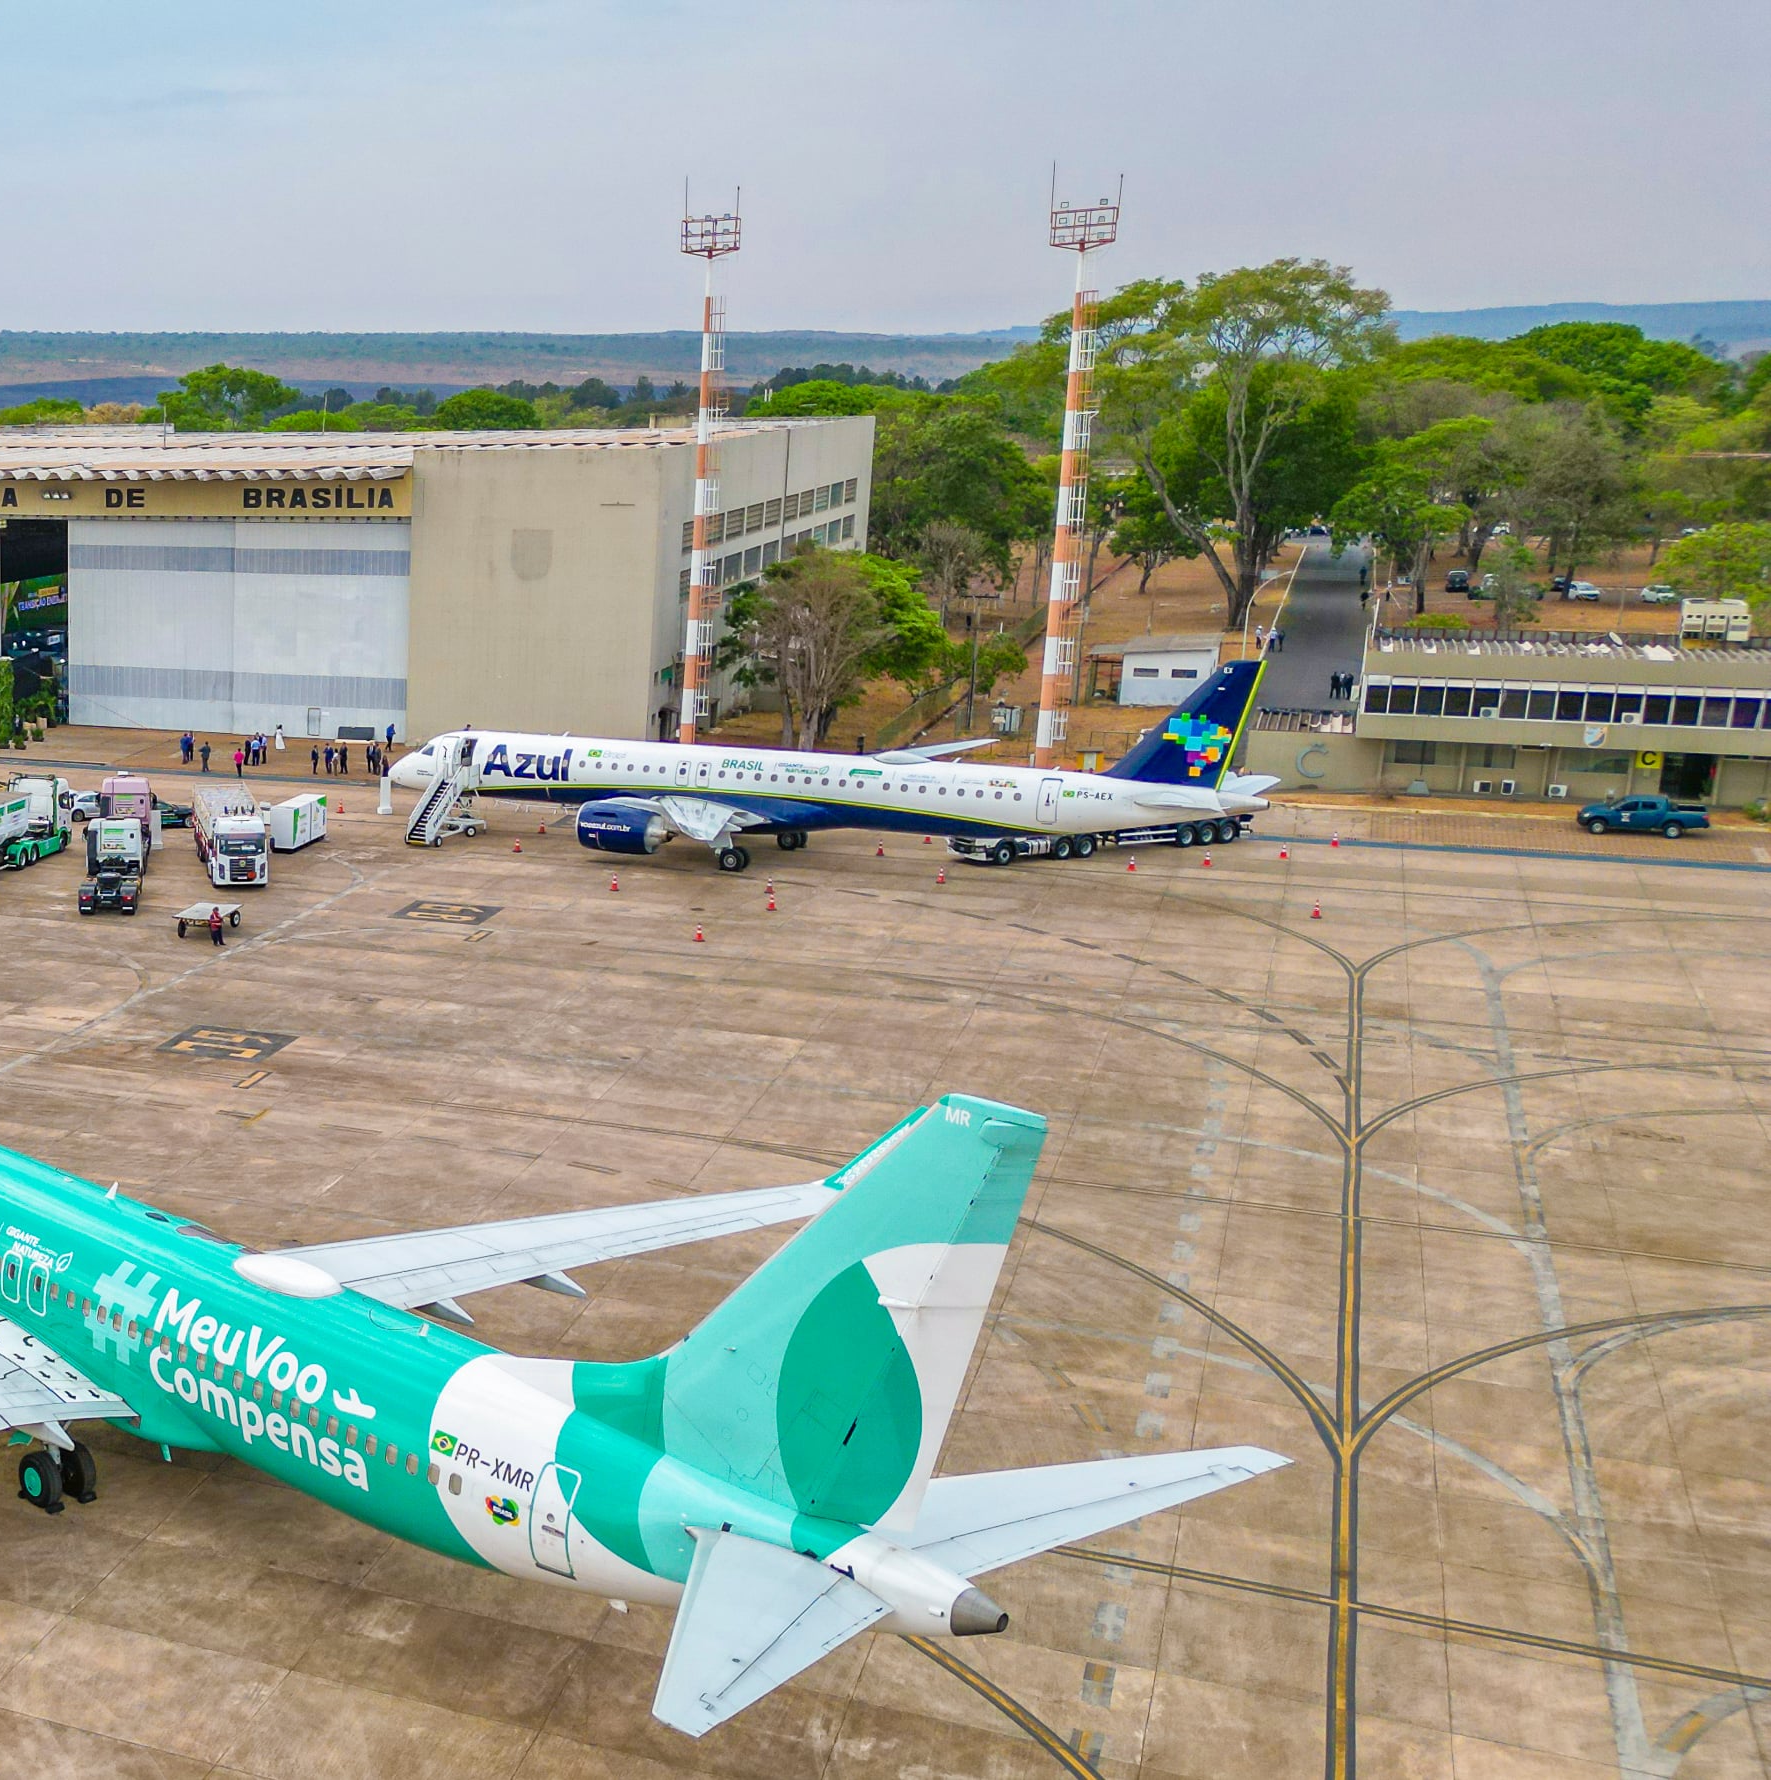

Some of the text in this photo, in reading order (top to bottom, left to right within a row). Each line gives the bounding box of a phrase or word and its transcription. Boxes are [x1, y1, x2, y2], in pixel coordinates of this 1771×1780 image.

[105, 488, 145, 508] DE
[242, 484, 395, 509] BRASÍLIA
[482, 744, 574, 782] Azul
[721, 758, 765, 772] BRASIL
[1641, 750, 1657, 765] C
[1077, 790, 1114, 801] PS-AEX
[945, 1106, 972, 1128] MR
[5, 1225, 41, 1247] GIGANTE
[11, 1240, 55, 1270] NATUREZA
[148, 1342, 371, 1493] Compensa
[454, 1442, 535, 1493] PR-XMR
